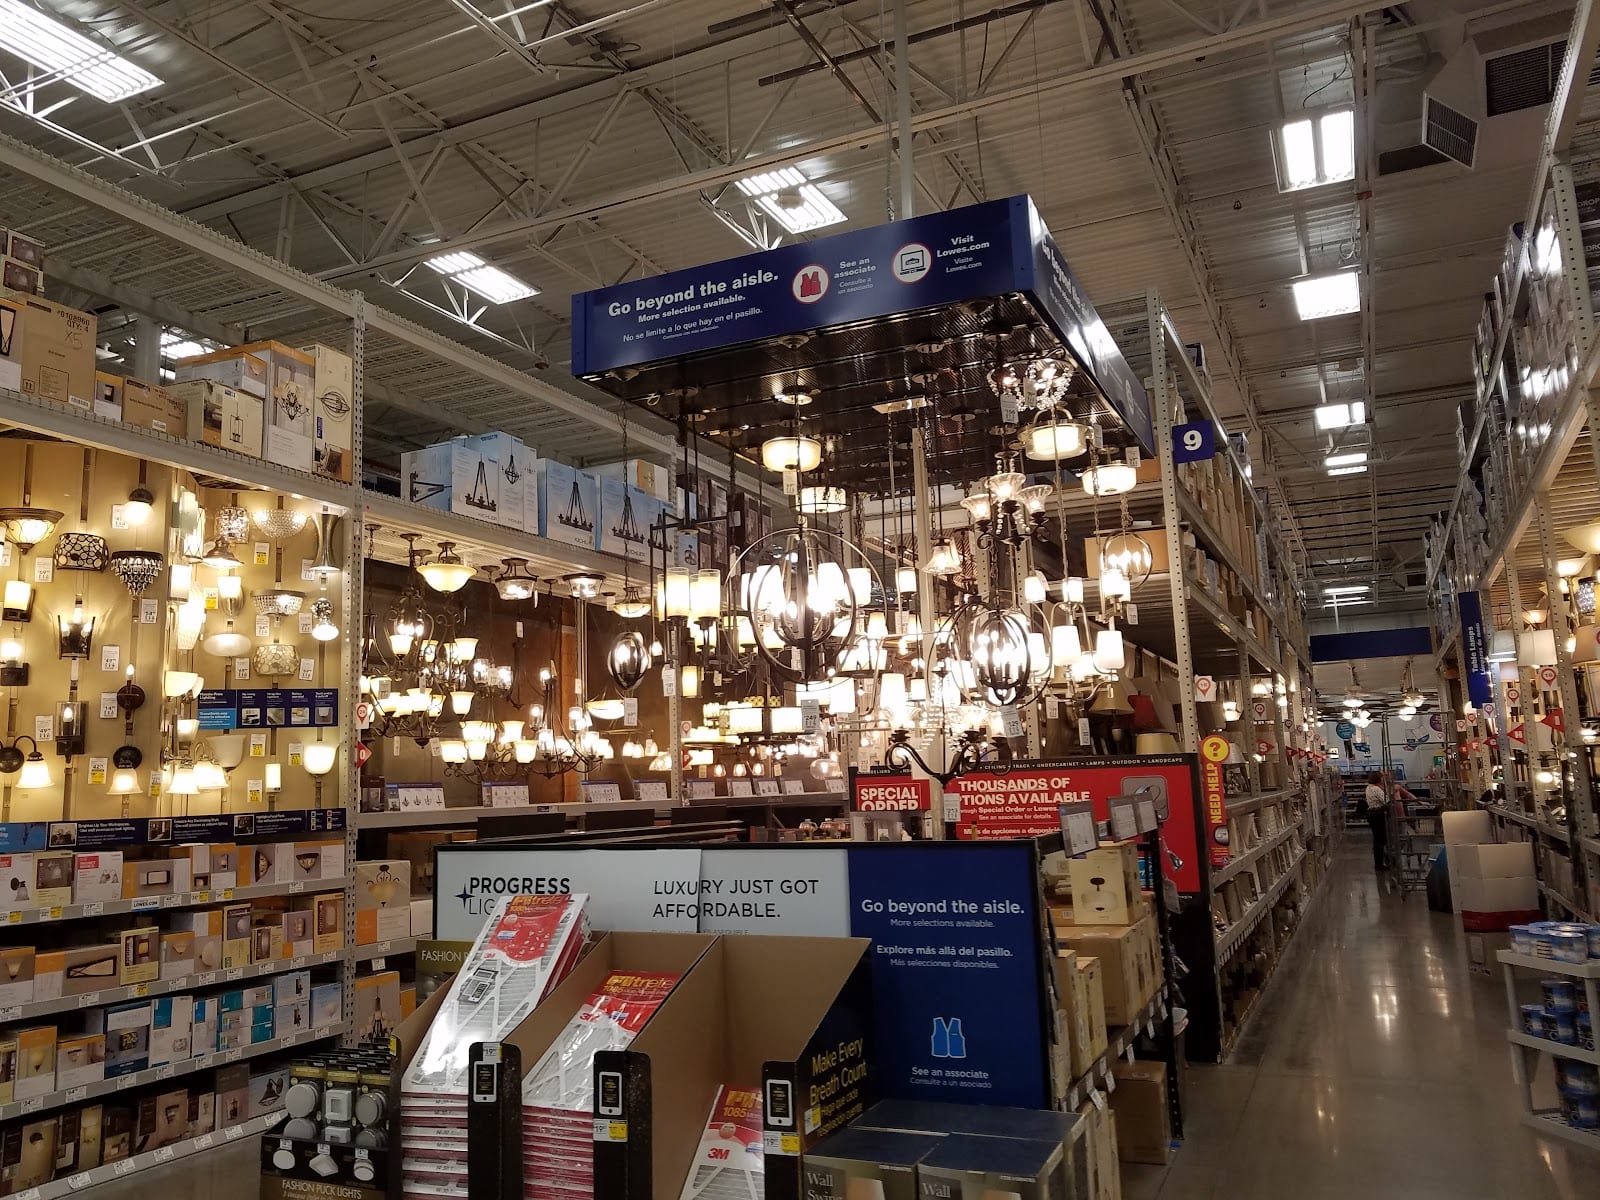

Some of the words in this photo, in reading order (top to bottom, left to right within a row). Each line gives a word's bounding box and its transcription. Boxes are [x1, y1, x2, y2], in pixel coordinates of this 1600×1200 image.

[951, 235, 974, 246] Visit
[937, 241, 990, 258] Lowes.com
[839, 260, 857, 269] See
[858, 257, 870, 266] an
[946, 261, 982, 273] Lowes.com
[954, 256, 973, 265] Visite
[833, 264, 876, 279] associate
[608, 302, 631, 317] Go
[636, 285, 695, 311] beyond
[699, 281, 727, 297] the
[732, 269, 779, 290] aisle.
[638, 313, 660, 323] More
[662, 304, 701, 318] selection
[703, 294, 746, 309] available.
[623, 334, 634, 342] No
[645, 328, 666, 338] limite
[683, 321, 697, 331] que
[699, 317, 713, 328] hay
[714, 315, 724, 323] en
[726, 312, 733, 320] el
[735, 307, 763, 321] pasillo.
[1183, 430, 1203, 451] 9
[1468, 626, 1476, 651] Lamps
[1471, 652, 1479, 673] Table
[958, 778, 1049, 792] THOUSANDS
[1051, 778, 1071, 789] OF
[1206, 763, 1220, 792] HELP
[860, 787, 919, 801] SPECIAL
[959, 794, 1005, 806] TIONS
[1008, 791, 1091, 805] AVAILABLE
[978, 806, 1004, 814] Special
[1209, 793, 1222, 824] NEED
[991, 828, 1021, 836] opciones
[469, 877, 571, 895] PROGRESS
[653, 879, 724, 896] LUXURY
[729, 879, 774, 895] JUST
[779, 879, 819, 895] GOT
[653, 903, 780, 918] AFFORDABLE.
[861, 899, 883, 914] Go
[887, 899, 947, 918] beyond
[951, 900, 978, 914] the
[983, 900, 1025, 914] aisle.
[890, 919, 912, 927] More
[913, 919, 954, 928] selections
[955, 919, 995, 929] available.
[421, 950, 461, 962] FASHION
[876, 944, 914, 958] Explore
[916, 945, 937, 956] más
[938, 945, 956, 956] allá
[958, 945, 975, 956] del
[977, 947, 1014, 959] pasillo.
[906, 959, 952, 968] selecciones
[952, 959, 1000, 970] disponibles.
[607, 975, 673, 989] Filtrete
[812, 1050, 838, 1077] Make
[838, 1038, 863, 1063] Every
[912, 1067, 929, 1077] See
[930, 1069, 944, 1078] an
[945, 1069, 989, 1080] associate
[810, 1073, 840, 1106] Breath
[841, 1059, 867, 1087] Count
[910, 1077, 940, 1086] Consulte
[723, 1106, 747, 1118] 1085
[707, 1148, 730, 1160] 3M
[807, 1172, 833, 1187] Wall
[282, 1179, 315, 1192] FASHION
[316, 1185, 336, 1195] PUCK
[337, 1187, 362, 1200] LIGHTS
[922, 1182, 951, 1198] Wall
